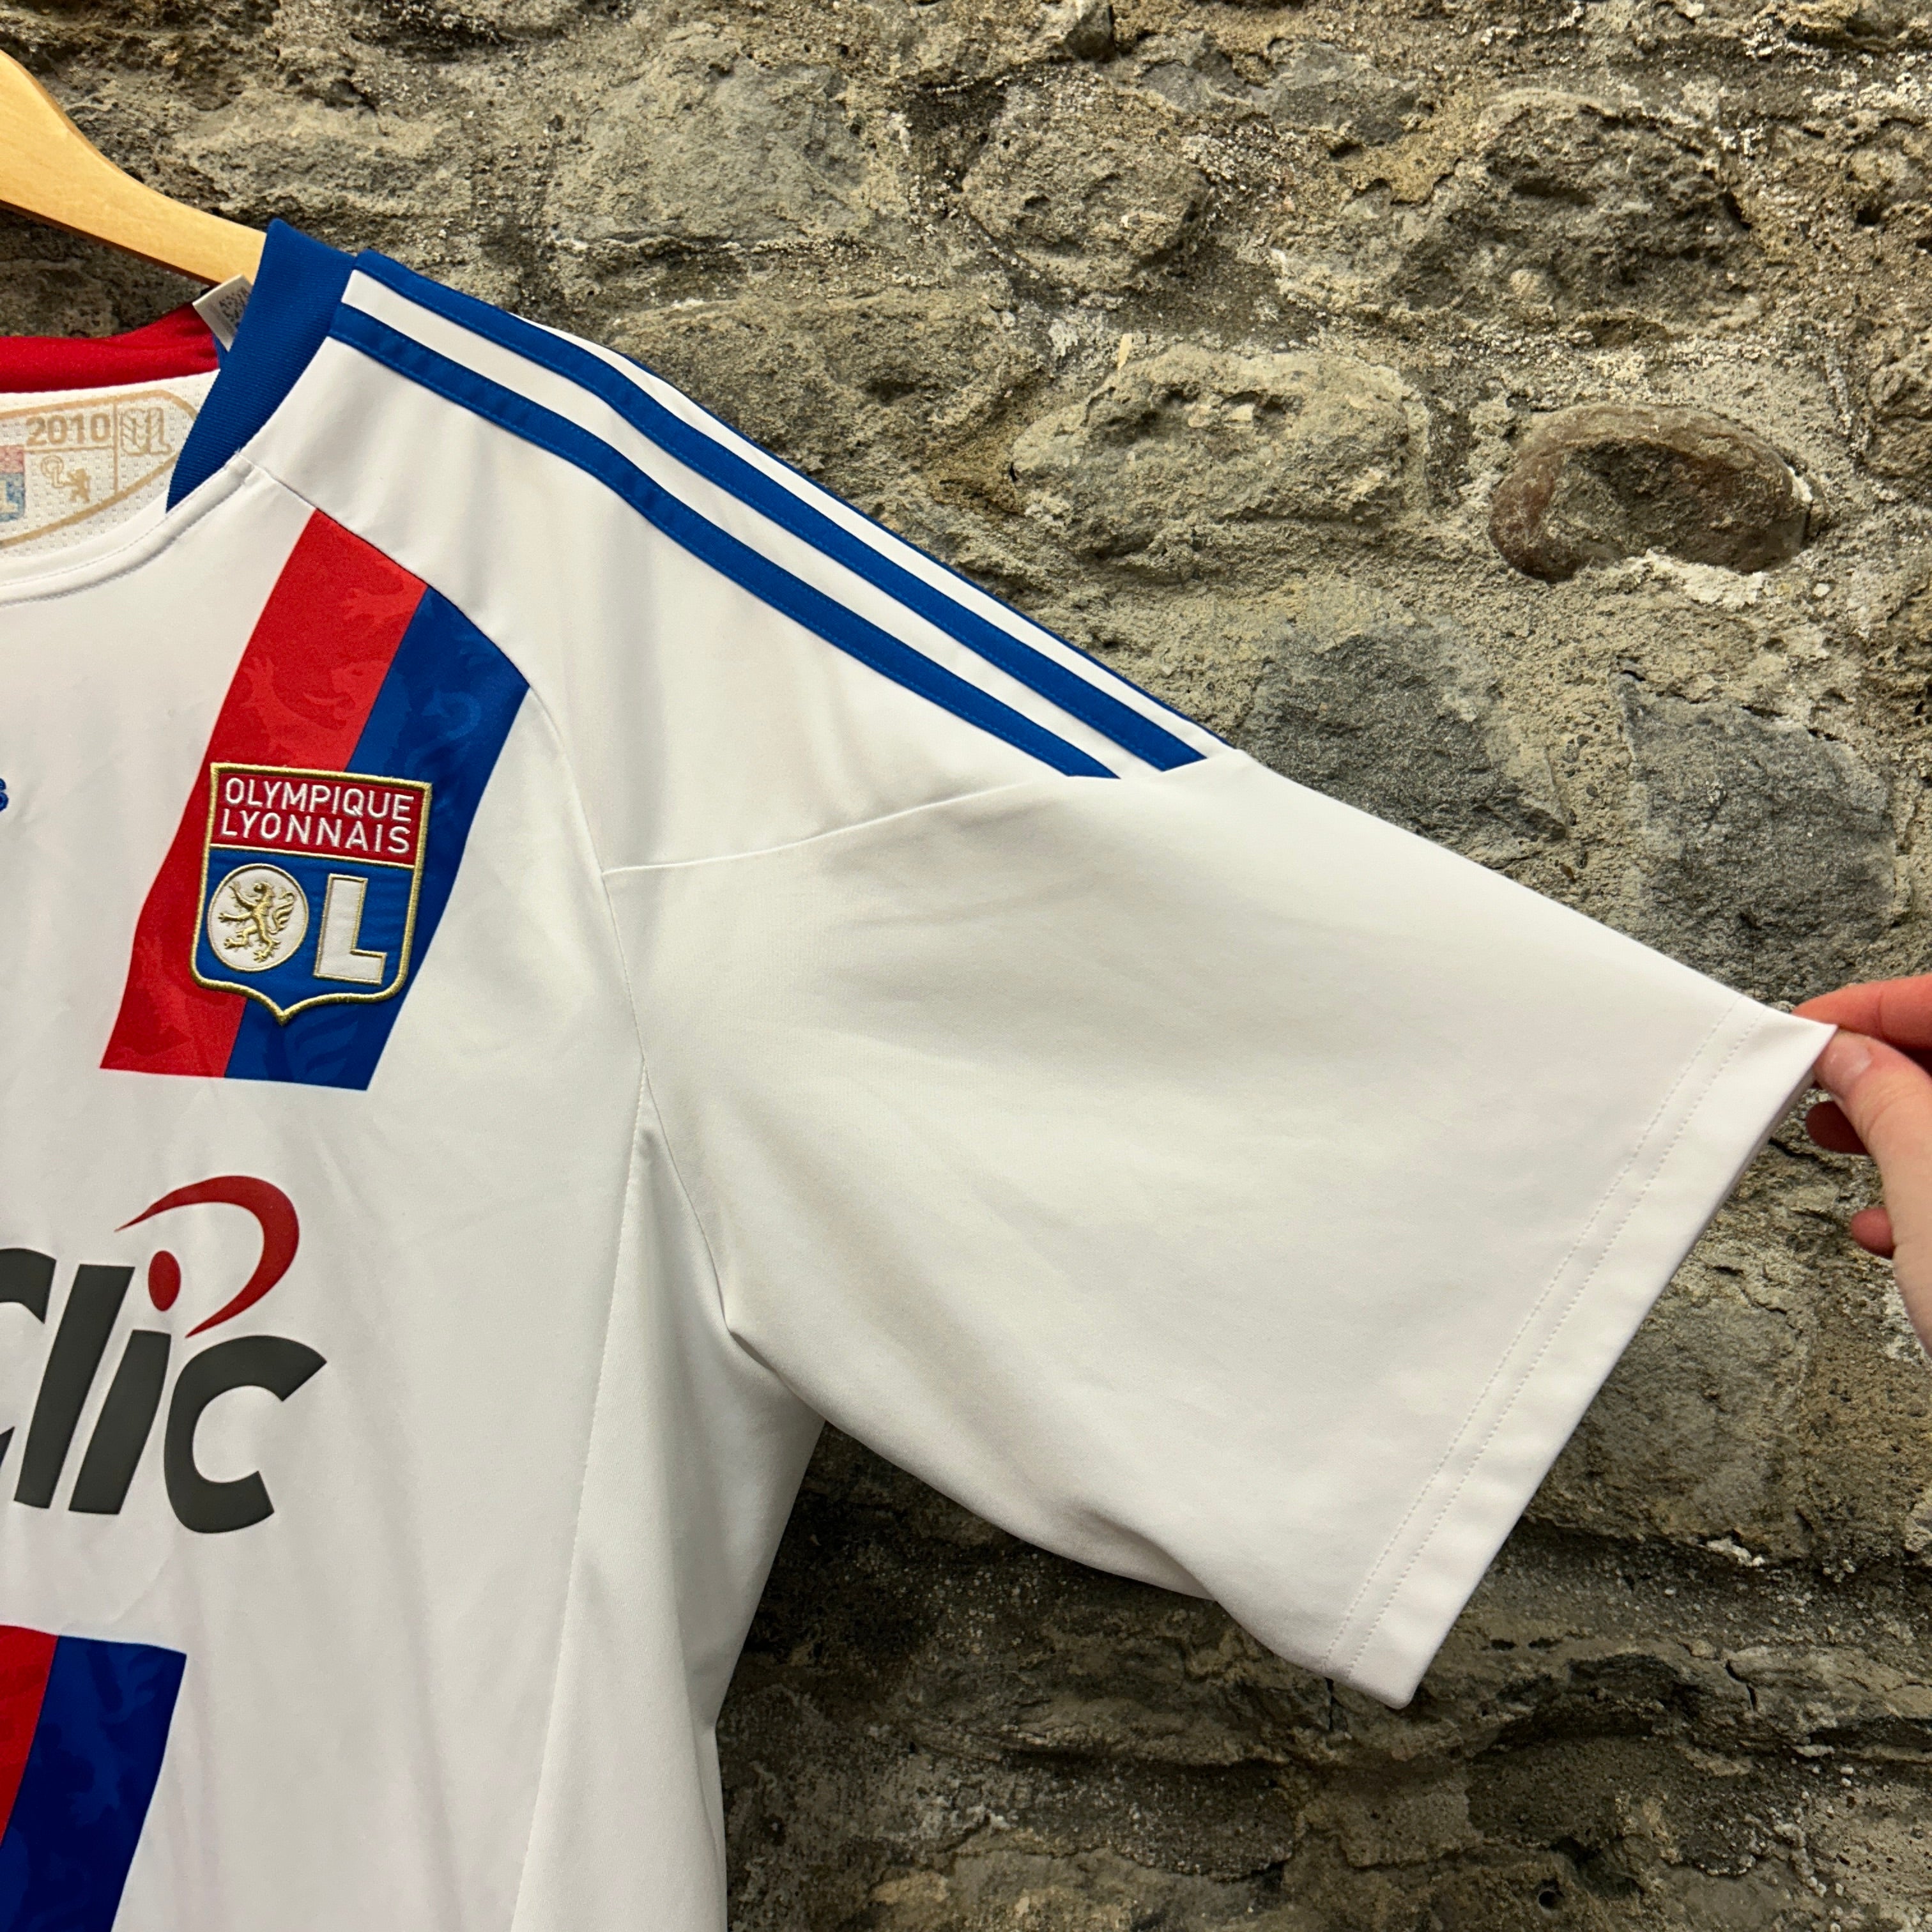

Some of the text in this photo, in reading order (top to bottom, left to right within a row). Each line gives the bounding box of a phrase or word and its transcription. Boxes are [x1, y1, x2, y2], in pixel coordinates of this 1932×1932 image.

[26, 413, 111, 445] 2010
[226, 777, 415, 822] OLYMPIQUE
[220, 808, 410, 854] LYONNAIS
